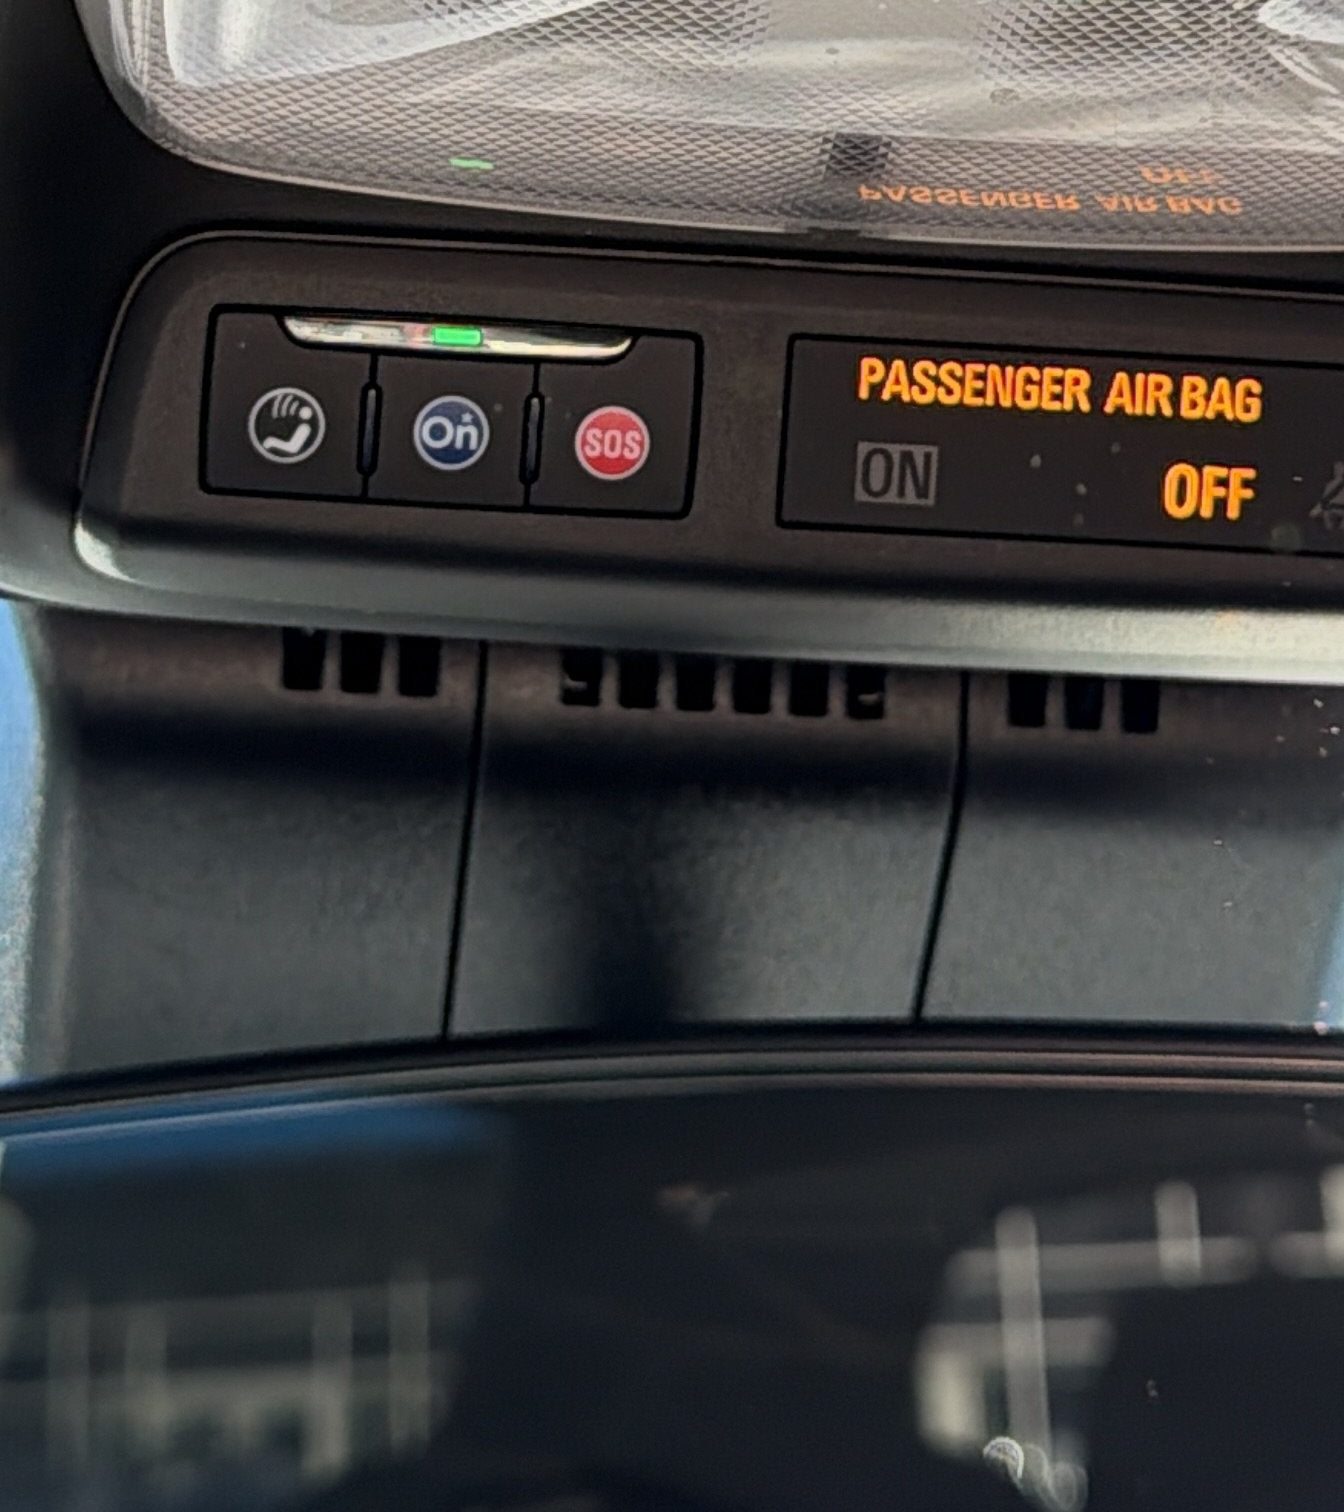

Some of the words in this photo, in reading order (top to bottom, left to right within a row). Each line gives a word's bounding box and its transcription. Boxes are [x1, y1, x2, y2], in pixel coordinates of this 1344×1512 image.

[858, 356, 1091, 413] PASSENGER
[1103, 371, 1174, 416] AIR
[1180, 376, 1263, 423] BAG
[422, 414, 478, 451] On
[585, 427, 641, 460] SOS
[860, 445, 933, 501] ON
[1163, 462, 1257, 520] OFF
